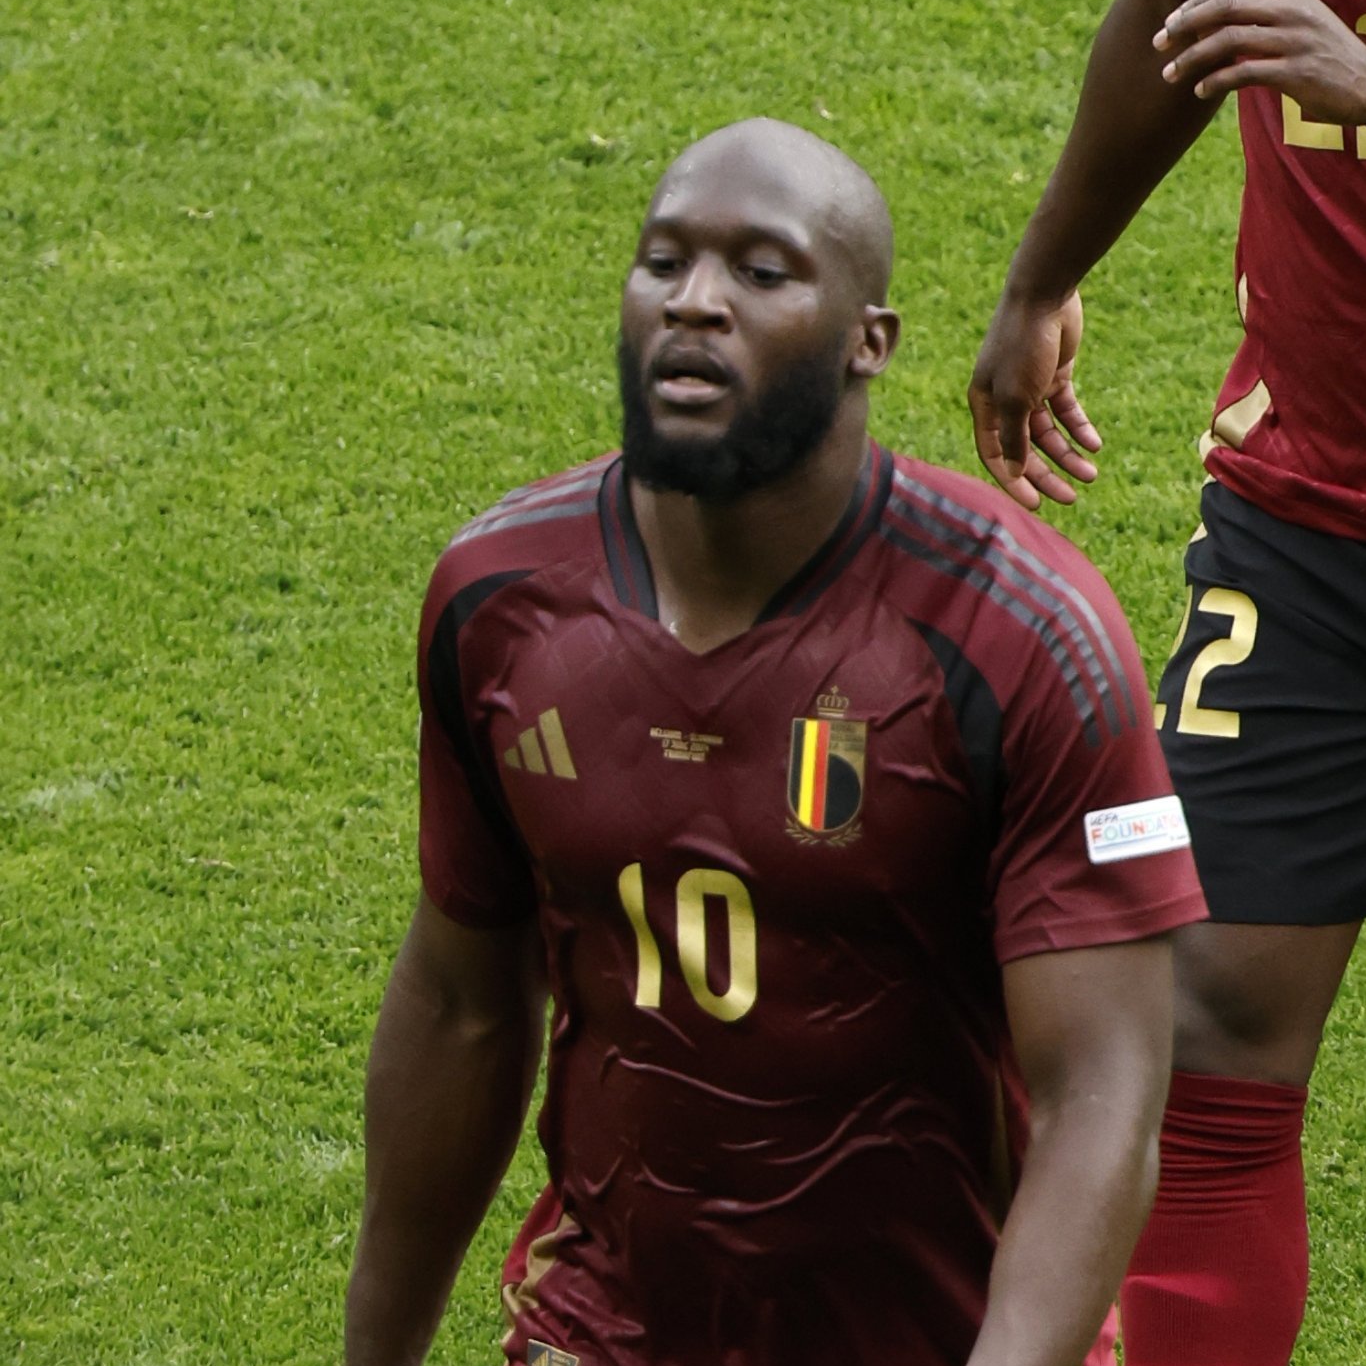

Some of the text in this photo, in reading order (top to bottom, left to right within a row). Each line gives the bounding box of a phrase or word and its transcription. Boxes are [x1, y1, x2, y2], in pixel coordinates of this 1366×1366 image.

[1090, 813, 1120, 826] UEFA
[1091, 814, 1185, 844] FOUNDATO
[618, 862, 758, 1022] 10
